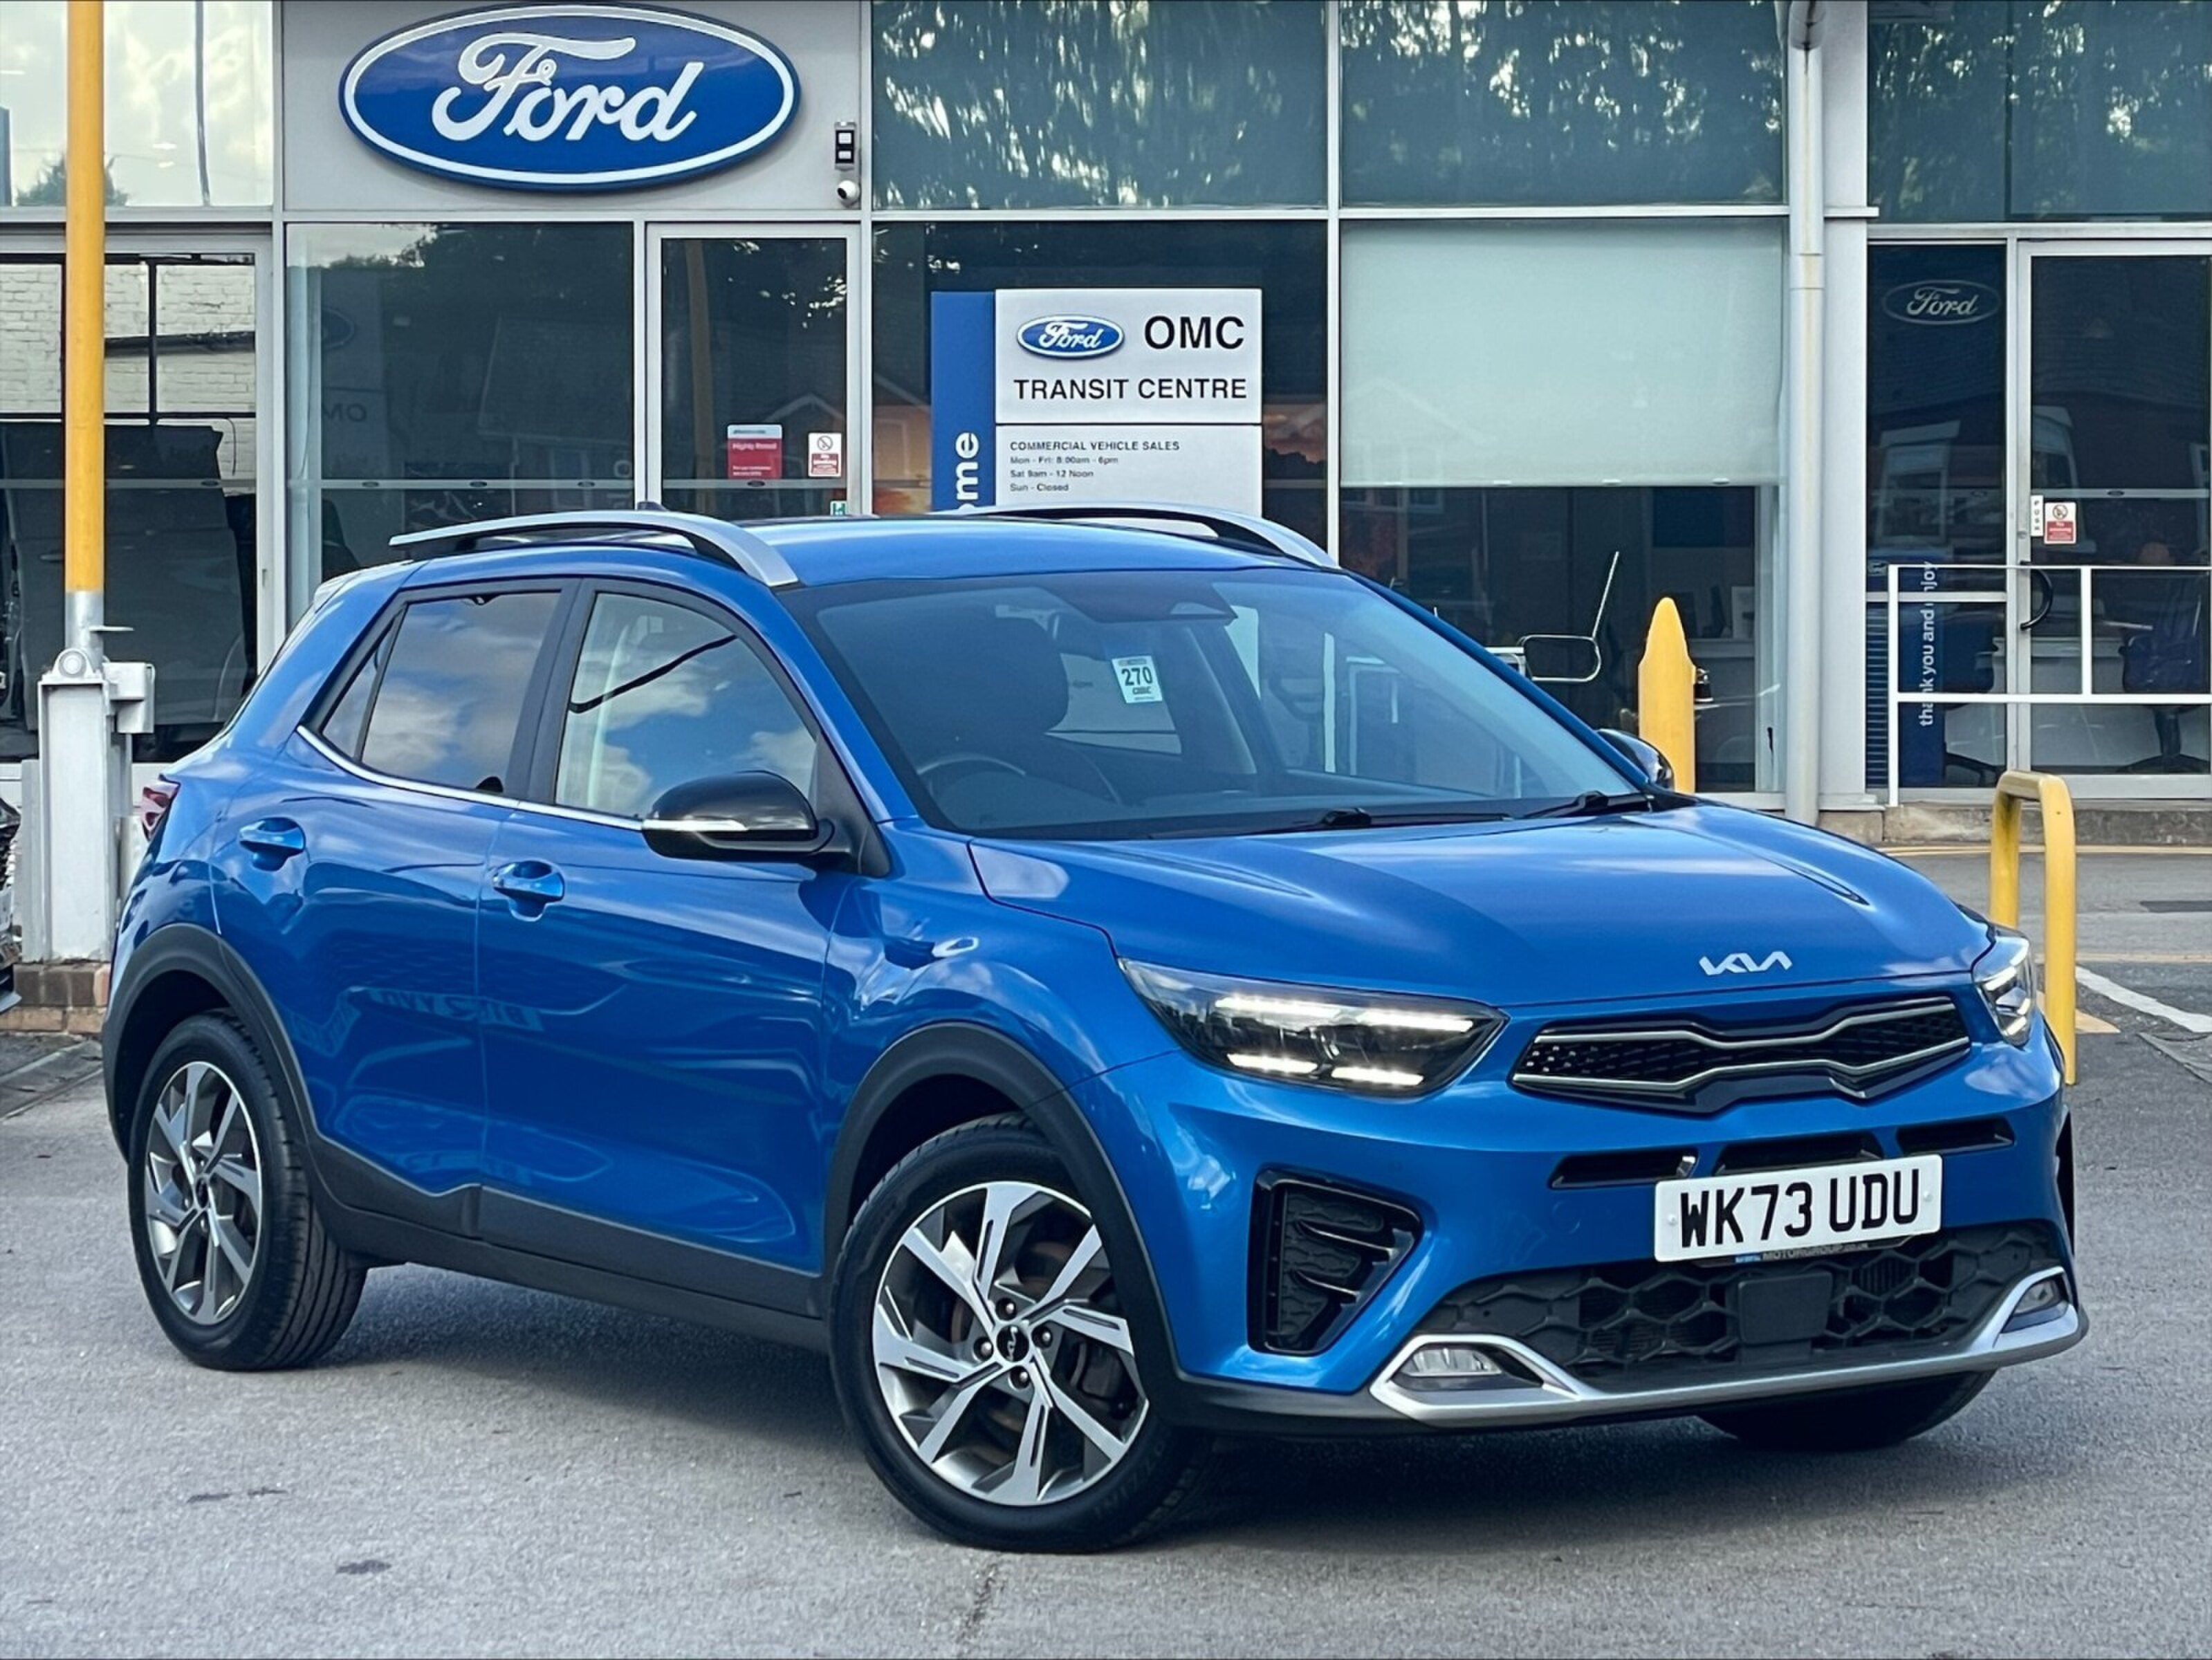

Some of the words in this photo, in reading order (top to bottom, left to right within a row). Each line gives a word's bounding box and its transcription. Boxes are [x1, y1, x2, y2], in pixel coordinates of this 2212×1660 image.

[432, 33, 704, 141] Ford
[1907, 286, 1979, 315] Ford
[1039, 321, 1103, 348] Ford
[1144, 315, 1244, 349] OMC
[1013, 379, 1129, 399] TRANSIT
[1138, 379, 1246, 399] CENTRE
[1010, 441, 1086, 451] COMMERCIAL
[1090, 441, 1139, 451] VEHICLE
[1142, 441, 1180, 451] SALES
[1098, 456, 1118, 465] 6pm
[1010, 483, 1029, 492] Sun
[1037, 483, 1069, 492] Closed
[1920, 609, 1935, 641] and
[1922, 645, 1936, 674] you
[1121, 666, 1153, 686] 270
[1699, 951, 1792, 976] KIA
[1680, 1181, 1812, 1248] WK73
[1829, 1168, 1919, 1233] UDU
